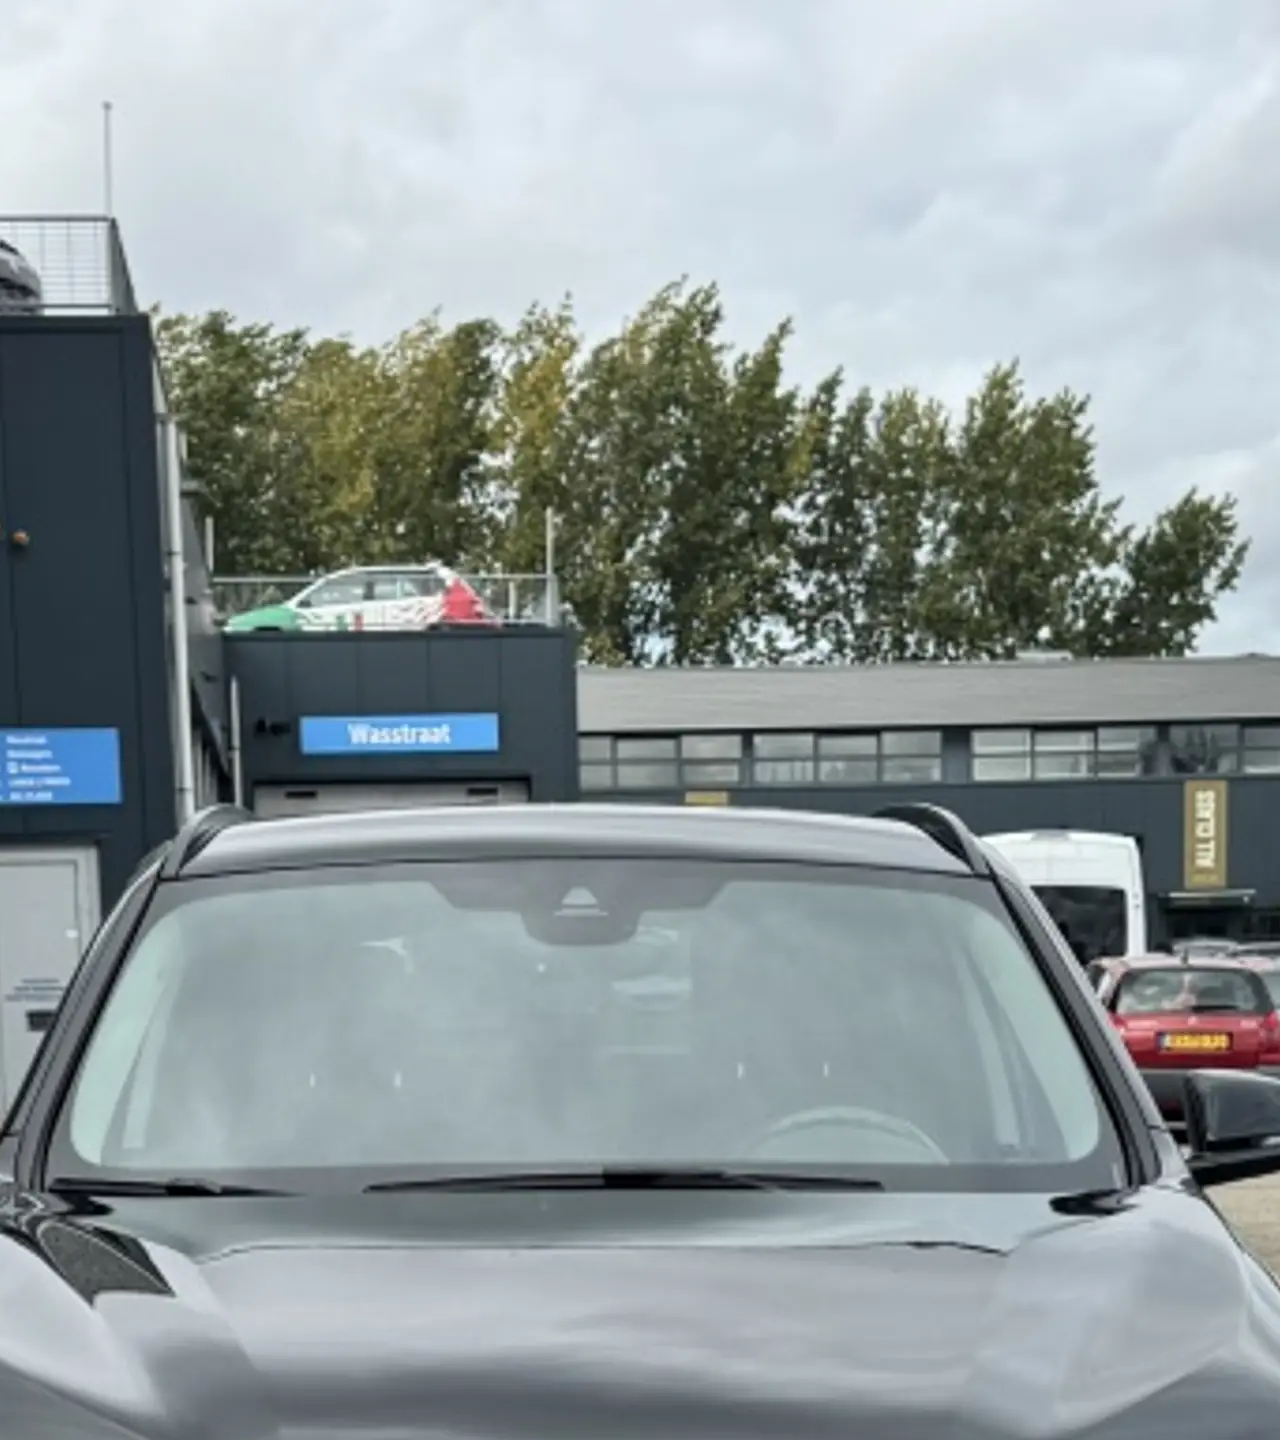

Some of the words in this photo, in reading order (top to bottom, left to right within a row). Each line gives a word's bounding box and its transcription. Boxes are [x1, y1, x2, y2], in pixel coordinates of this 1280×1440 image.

[347, 723, 451, 745] Wasstraat
[1195, 790, 1215, 837] CLASS
[1195, 839, 1215, 868] ALL
